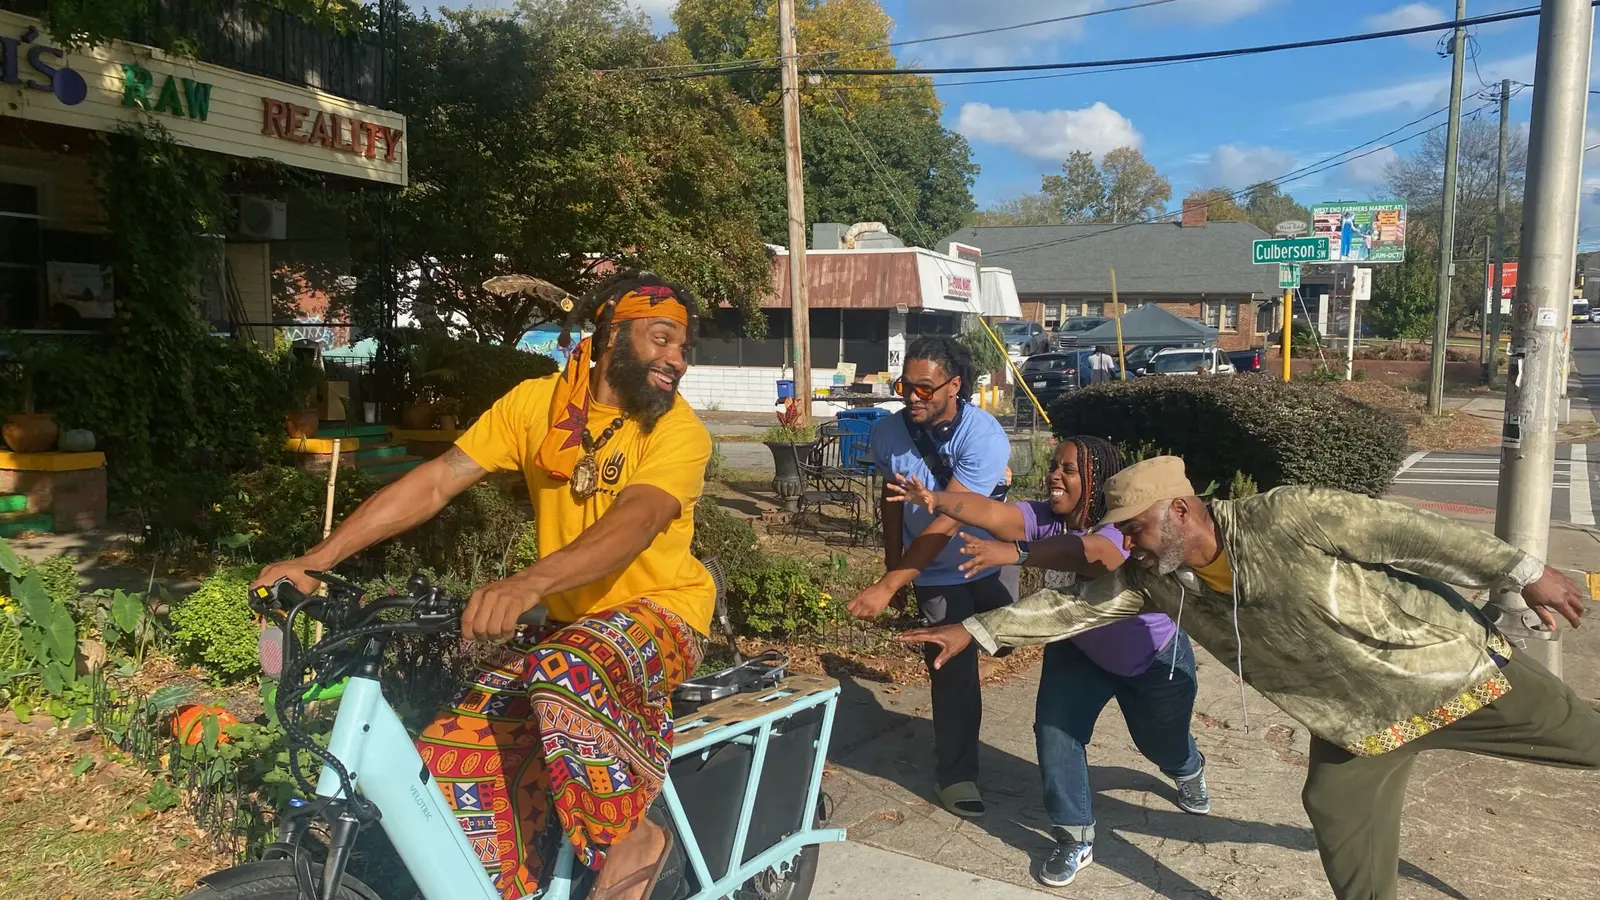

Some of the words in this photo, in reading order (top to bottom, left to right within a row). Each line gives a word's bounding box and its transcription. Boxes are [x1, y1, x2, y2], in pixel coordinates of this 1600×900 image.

[122, 63, 213, 121] RAW
[261, 97, 404, 161] REALITY
[1342, 205, 1368, 213] FARMERS
[1256, 245, 1315, 260] Culberson
[1318, 240, 1325, 248] ST
[1317, 249, 1326, 258] SW
[410, 784, 432, 822] VELOTRIC
